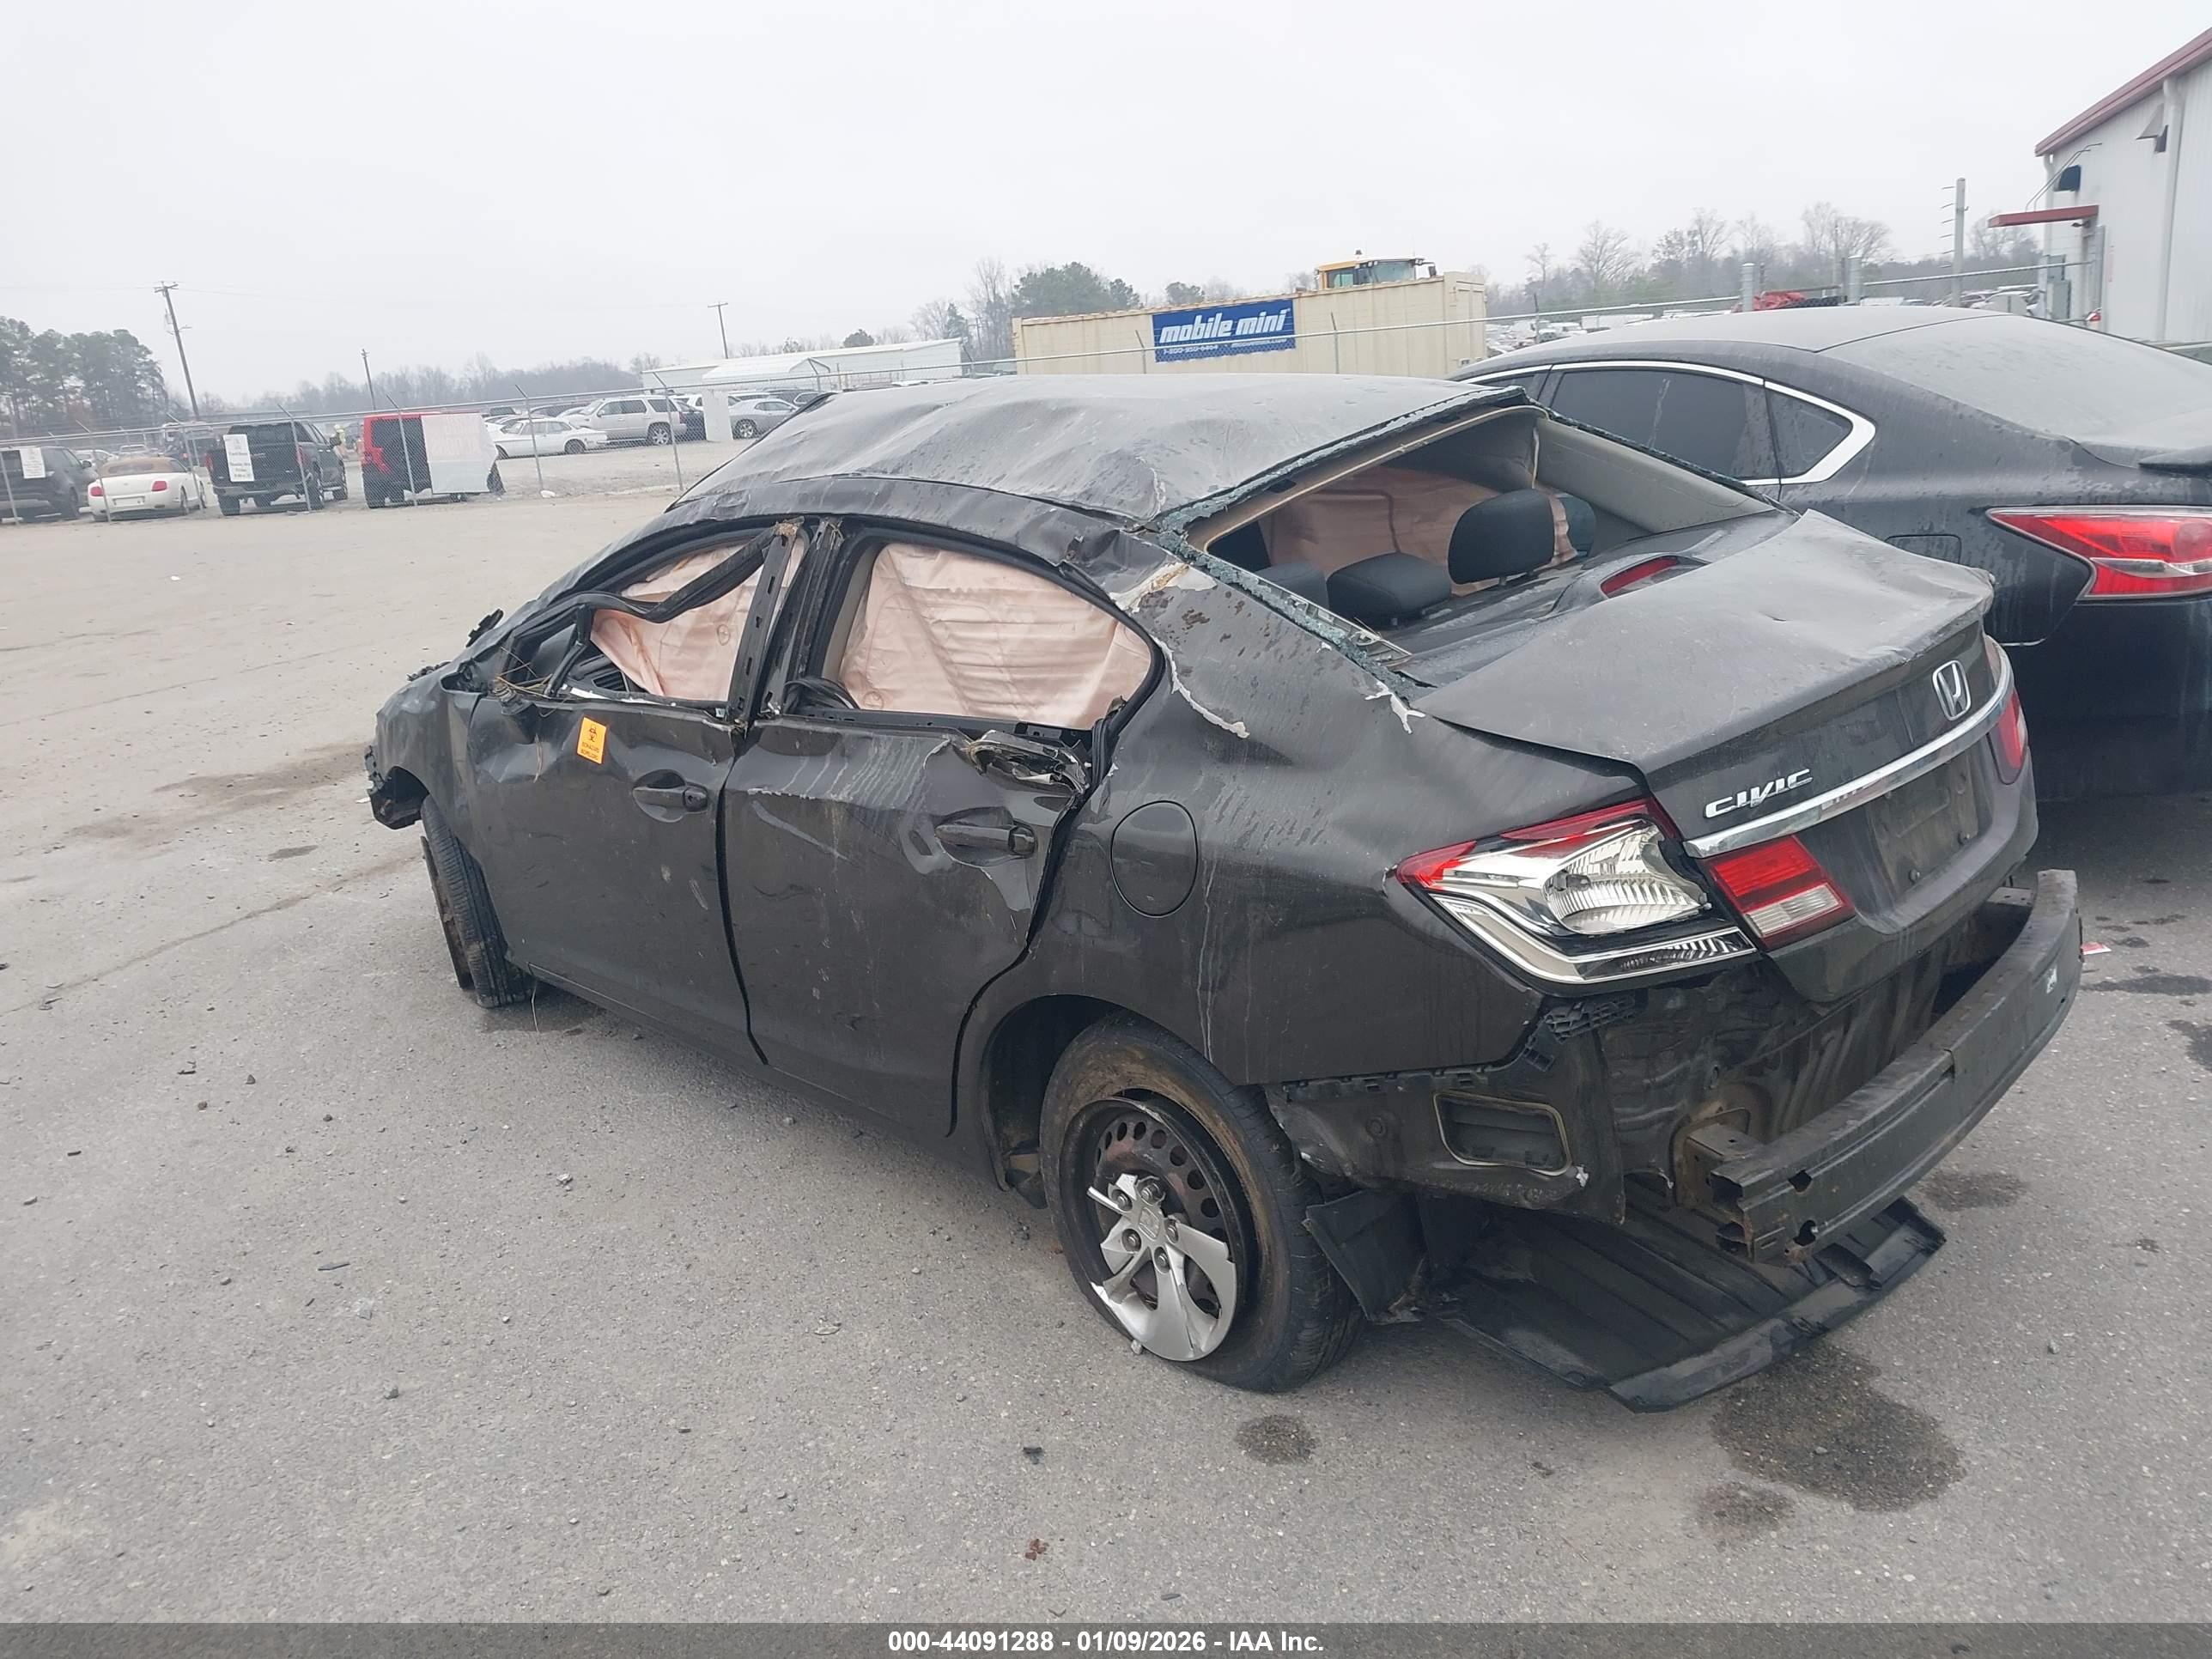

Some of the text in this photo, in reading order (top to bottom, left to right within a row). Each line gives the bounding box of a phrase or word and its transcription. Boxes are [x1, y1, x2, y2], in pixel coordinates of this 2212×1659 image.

[1159, 308, 1288, 343] mobile mini
[1705, 768, 1814, 818] CIVIC
